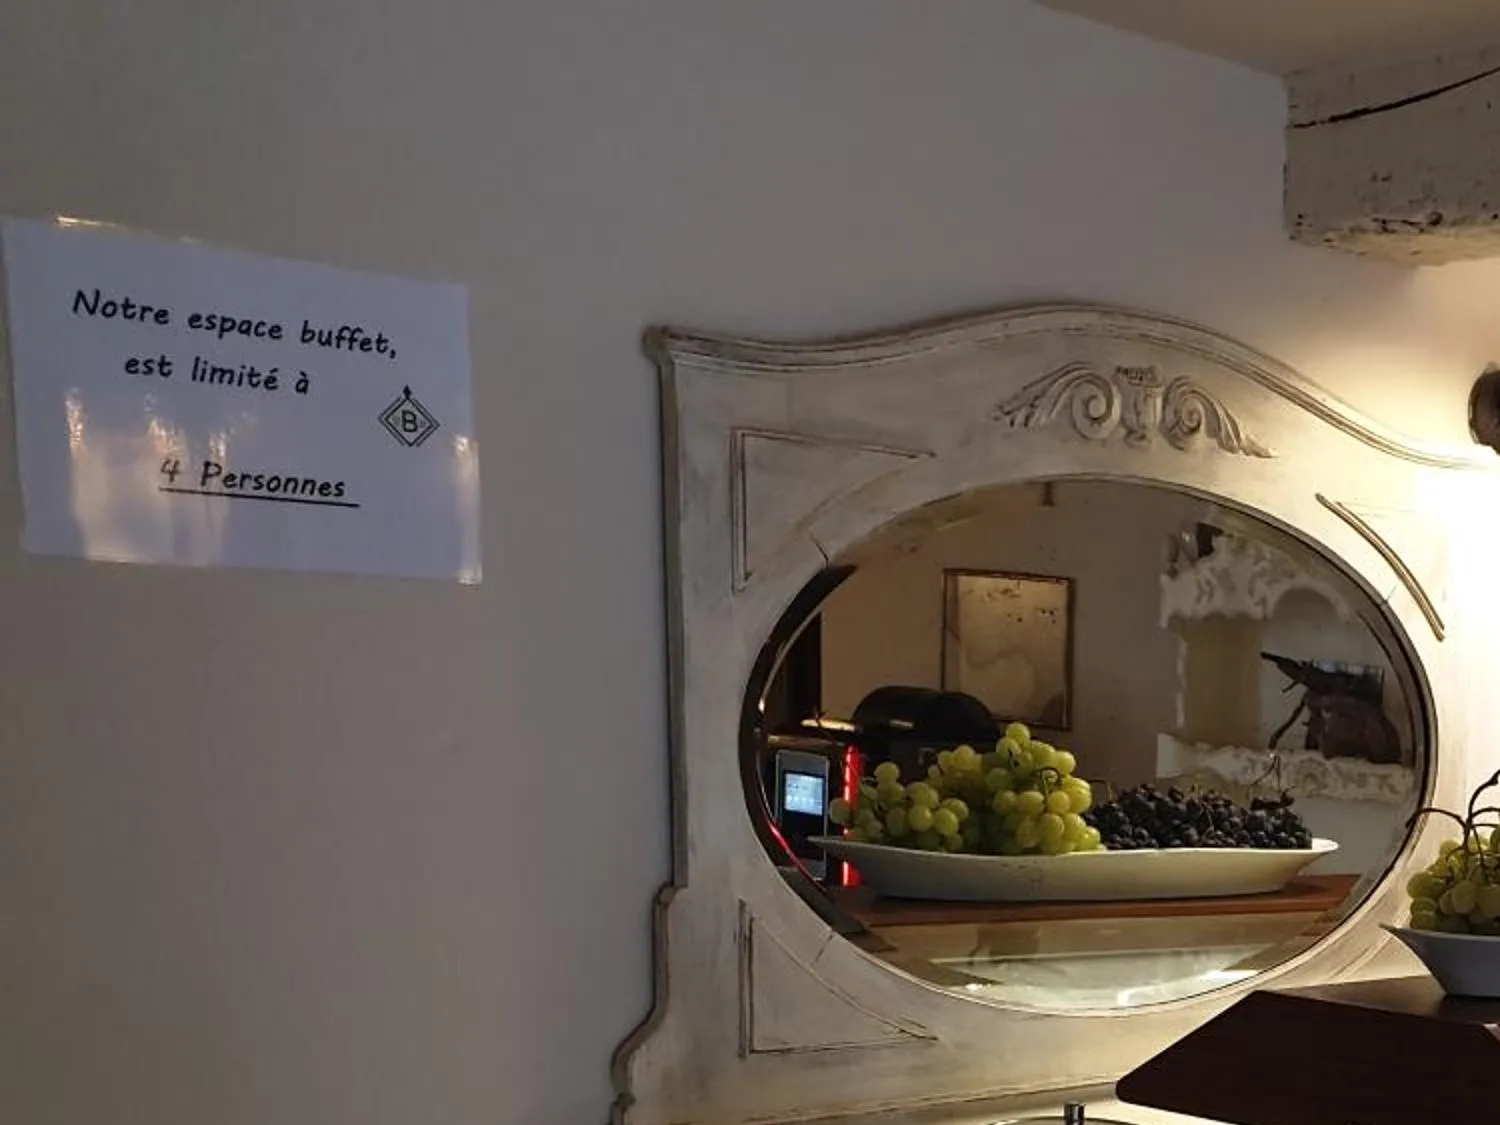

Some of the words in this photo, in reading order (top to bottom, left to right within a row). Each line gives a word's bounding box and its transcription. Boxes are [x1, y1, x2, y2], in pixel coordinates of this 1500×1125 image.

[72, 288, 170, 326] Notre
[187, 312, 284, 341] espace
[299, 319, 398, 360] buffet,
[124, 353, 173, 378] est
[191, 355, 279, 391] limité
[295, 371, 310, 395] à
[402, 409, 418, 433] B
[160, 459, 180, 483] 4
[200, 460, 346, 498] Personnes
